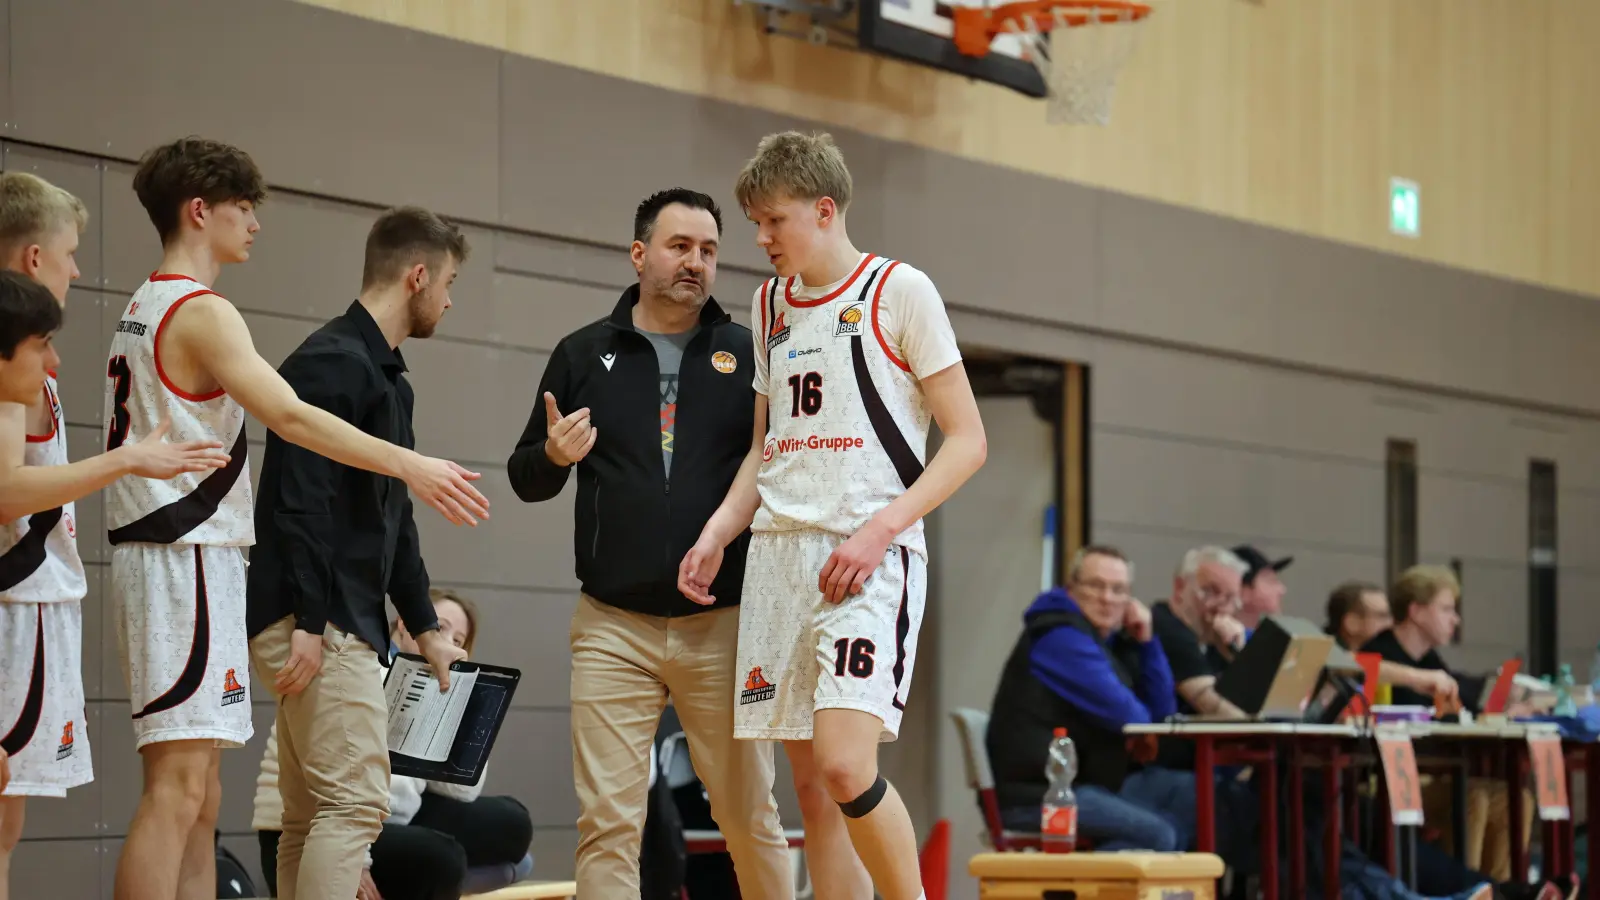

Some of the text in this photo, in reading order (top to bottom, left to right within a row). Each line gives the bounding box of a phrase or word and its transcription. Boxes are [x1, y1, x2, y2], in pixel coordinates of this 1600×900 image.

[835, 322, 859, 335] JBBL
[788, 371, 823, 418] 16
[777, 435, 864, 453] Witt-Gruppe
[834, 637, 876, 679] 16
